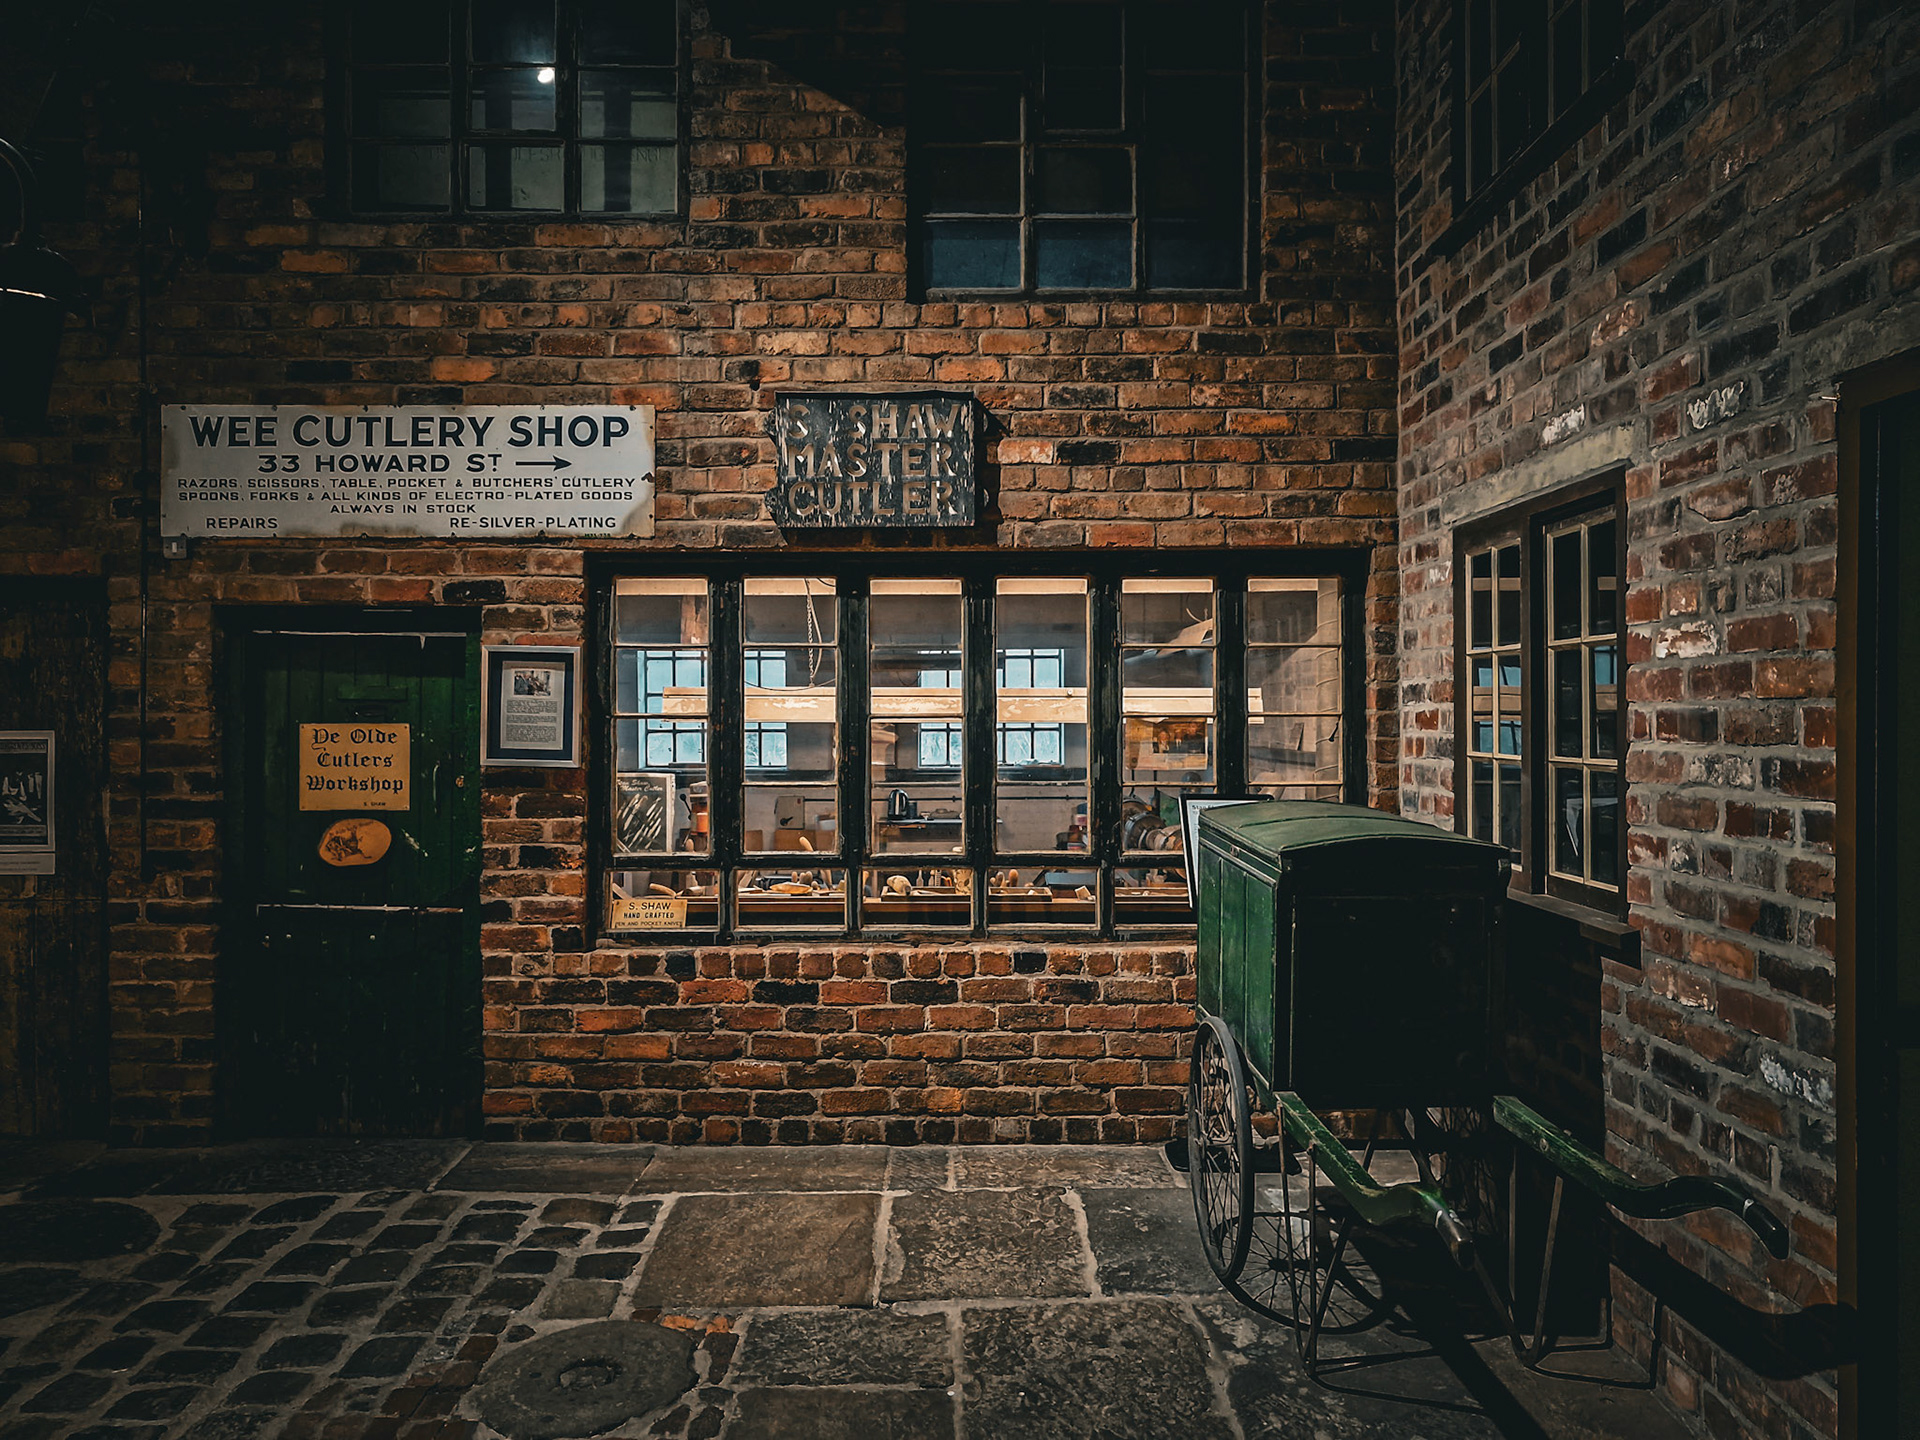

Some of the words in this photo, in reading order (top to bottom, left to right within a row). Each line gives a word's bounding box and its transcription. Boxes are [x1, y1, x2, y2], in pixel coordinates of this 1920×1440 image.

[849, 404, 960, 438] SHAW
[188, 416, 278, 448] WEE
[293, 414, 495, 448] CUTLERY
[507, 415, 629, 448] SHOP
[258, 455, 300, 473] 33
[315, 455, 450, 473] HOWARD
[788, 442, 956, 478] MASTER
[387, 479, 446, 488] POCKET
[455, 479, 463, 488] &
[561, 478, 636, 488] CUTLERY
[250, 491, 299, 501] FORKS
[307, 493, 314, 501] &
[320, 491, 350, 501] ALL
[356, 491, 402, 501] KINDS
[408, 491, 428, 500] OF
[435, 491, 575, 501] ELECTRO-PLATED
[580, 491, 634, 500] GOODS
[788, 481, 957, 517] CUTLER
[330, 504, 394, 514] ALWAYS
[402, 504, 417, 514] IN
[426, 504, 477, 514] STOCK
[206, 517, 278, 529] REPAIRS
[450, 516, 617, 528] RE-SILVER-PLATING
[350, 729, 398, 744] Olde
[317, 752, 394, 768] Cutlers
[306, 775, 404, 795] Workshop
[640, 902, 672, 911] SHAW
